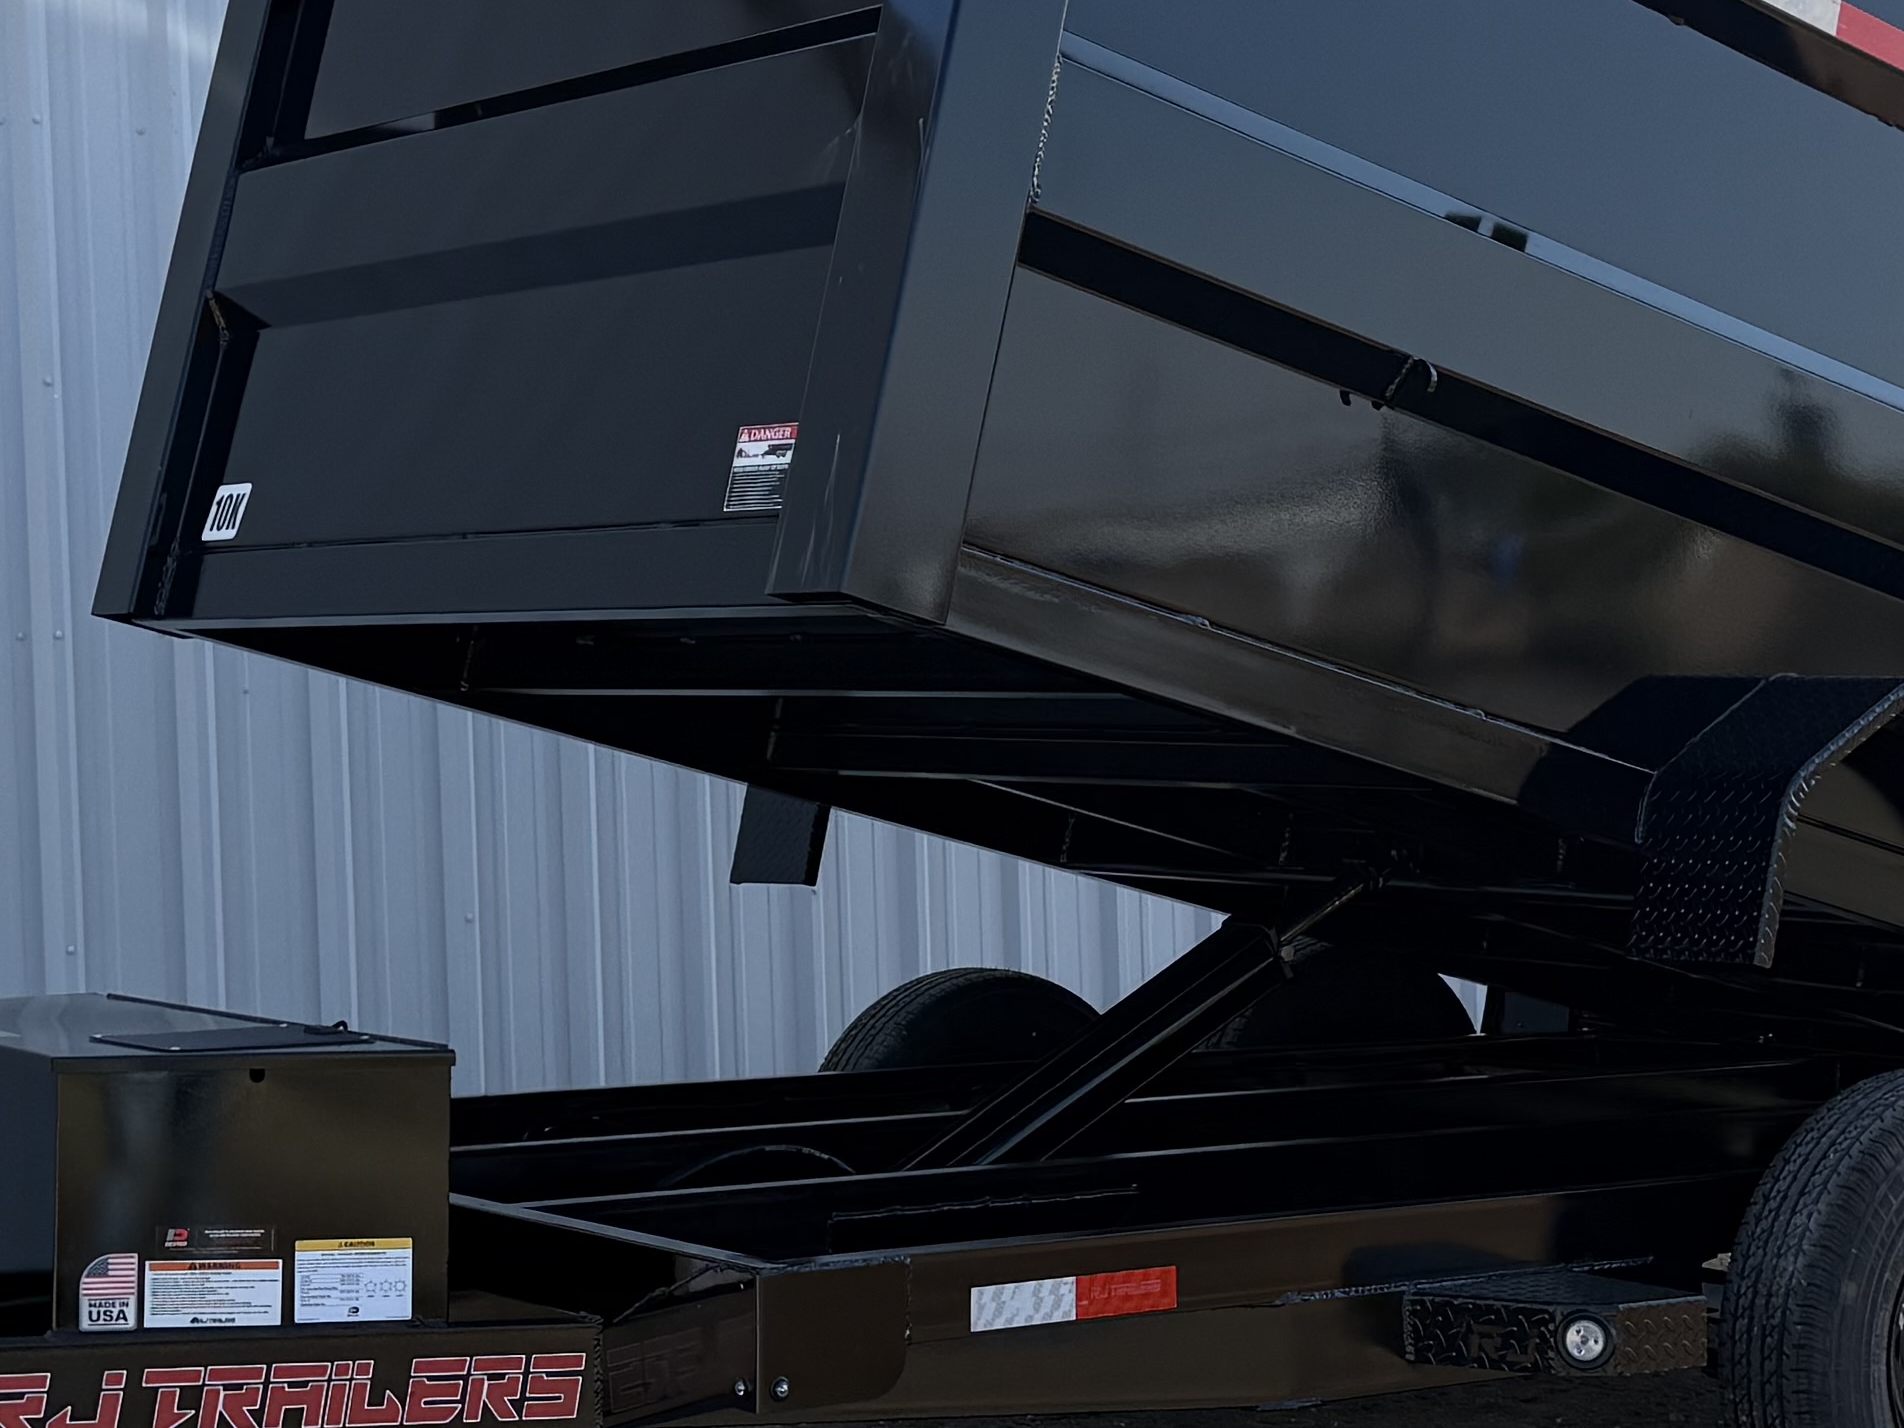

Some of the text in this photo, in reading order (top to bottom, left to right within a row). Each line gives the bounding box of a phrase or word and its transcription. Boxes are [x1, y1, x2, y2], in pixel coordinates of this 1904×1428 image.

[750, 426, 792, 441] DANGER
[209, 492, 247, 532] 10K
[118, 1300, 129, 1308] IN
[88, 1309, 128, 1323] USA
